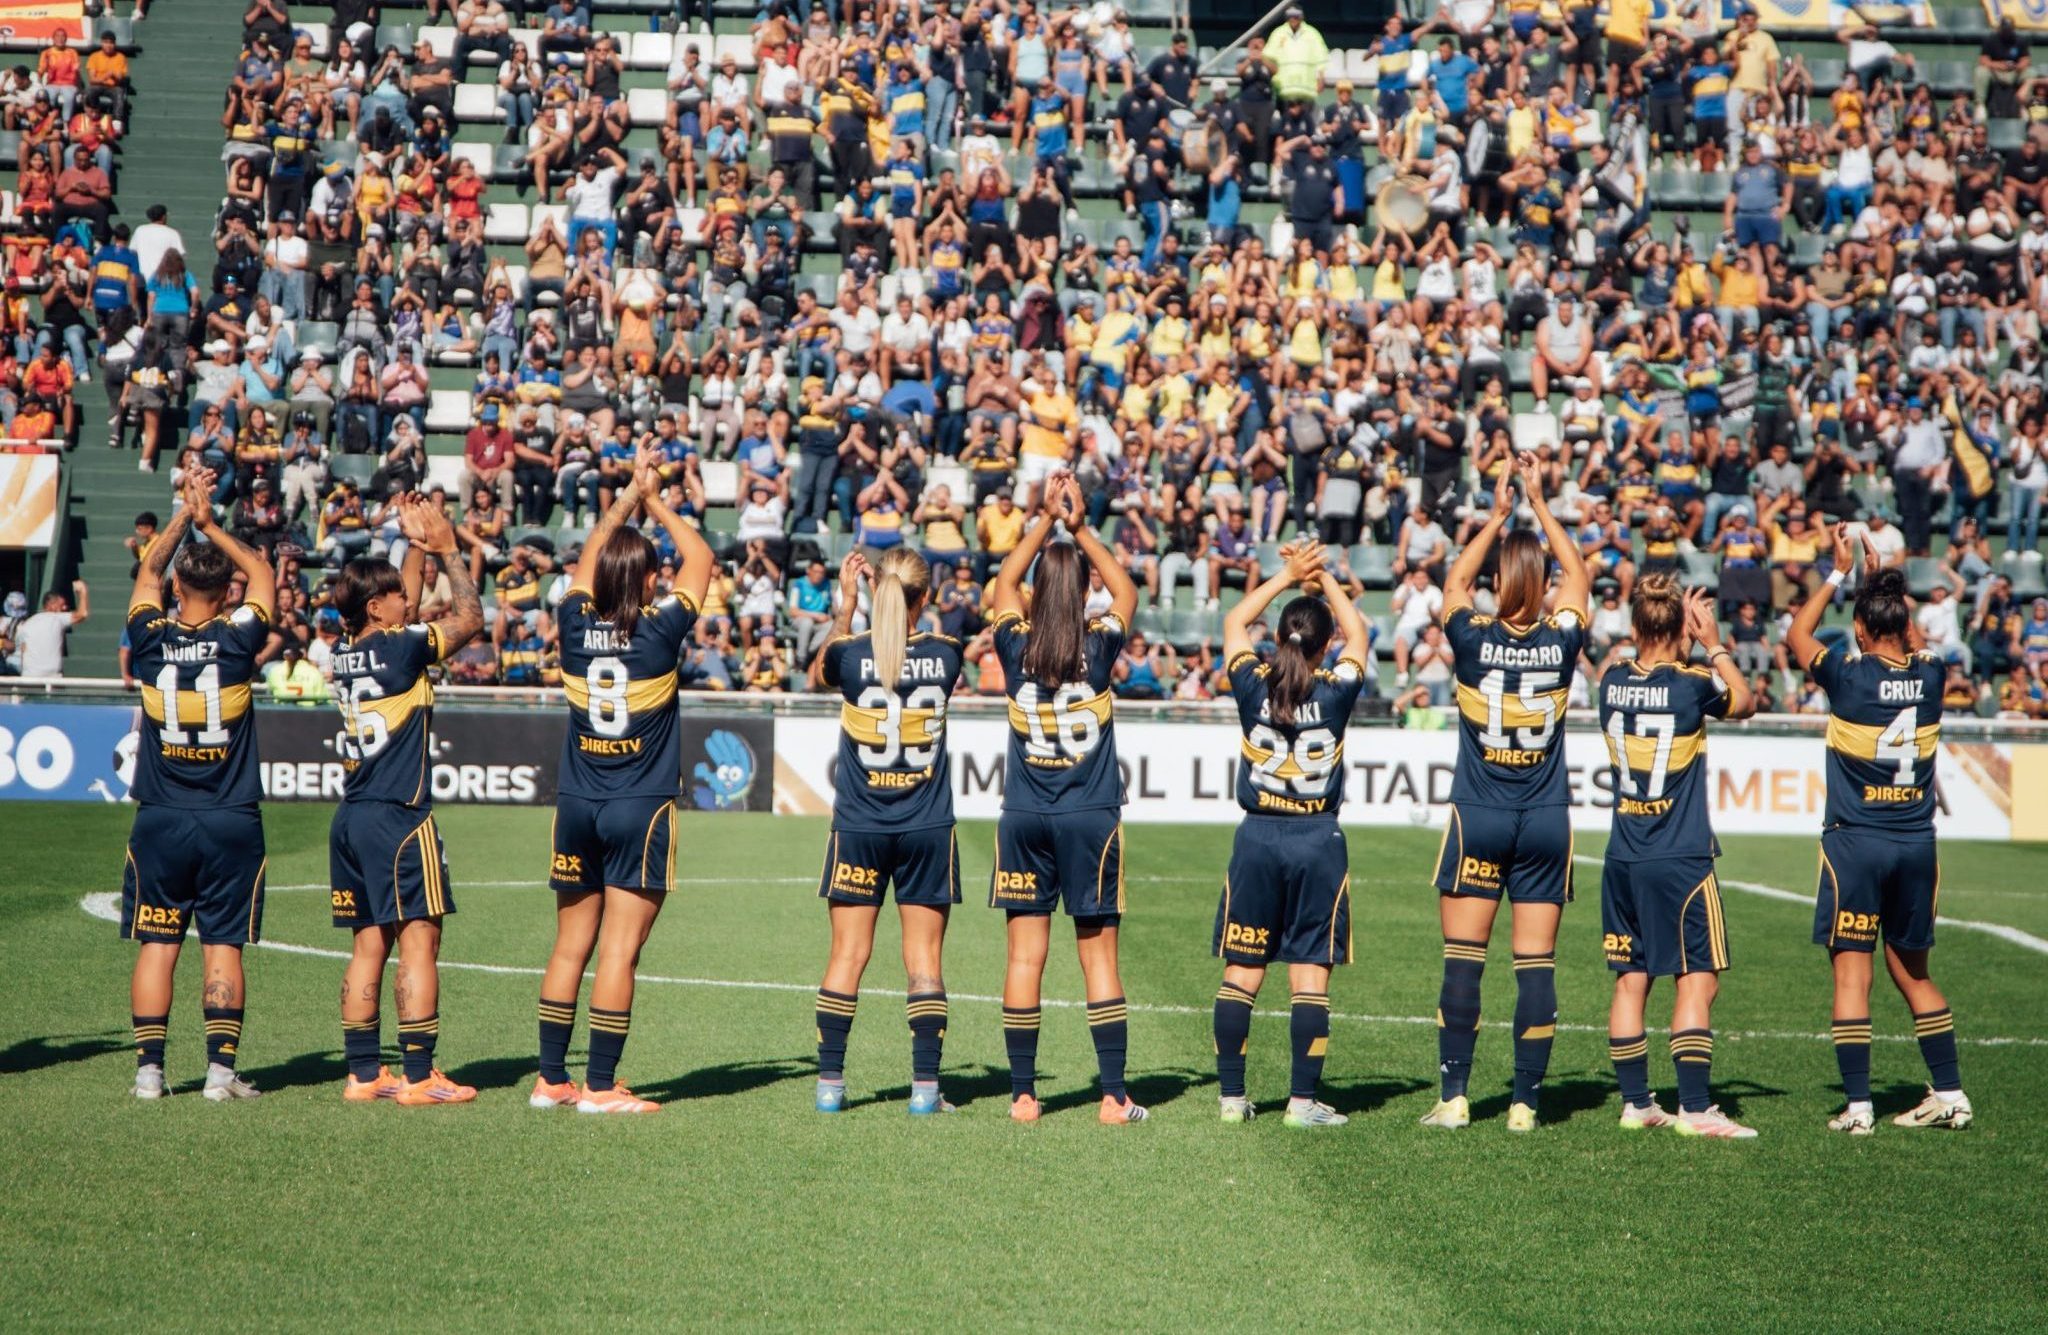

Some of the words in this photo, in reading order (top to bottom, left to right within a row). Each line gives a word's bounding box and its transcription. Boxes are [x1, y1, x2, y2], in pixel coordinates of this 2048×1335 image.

[369, 650, 386, 670] L.
[1480, 642, 1563, 666] BACCARO
[587, 656, 628, 736] 8
[1606, 684, 1669, 707] RUFFINI
[1879, 680, 1924, 700] CRUZ
[156, 664, 230, 743] 11
[1479, 669, 1560, 749] 15
[858, 686, 946, 766] 33
[1016, 681, 1100, 757] 16
[162, 742, 228, 760] DIRECTV
[579, 735, 641, 754] DIRECTV
[1607, 711, 1675, 797] 17
[1875, 706, 1920, 785] 4
[1258, 791, 1326, 811] DIRECTV
[835, 863, 878, 886] pax
[1462, 857, 1500, 878] pax
[998, 871, 1036, 891] pax
[138, 905, 180, 924] pax
[1838, 910, 1880, 931] pax
[1227, 923, 1270, 945] pax
